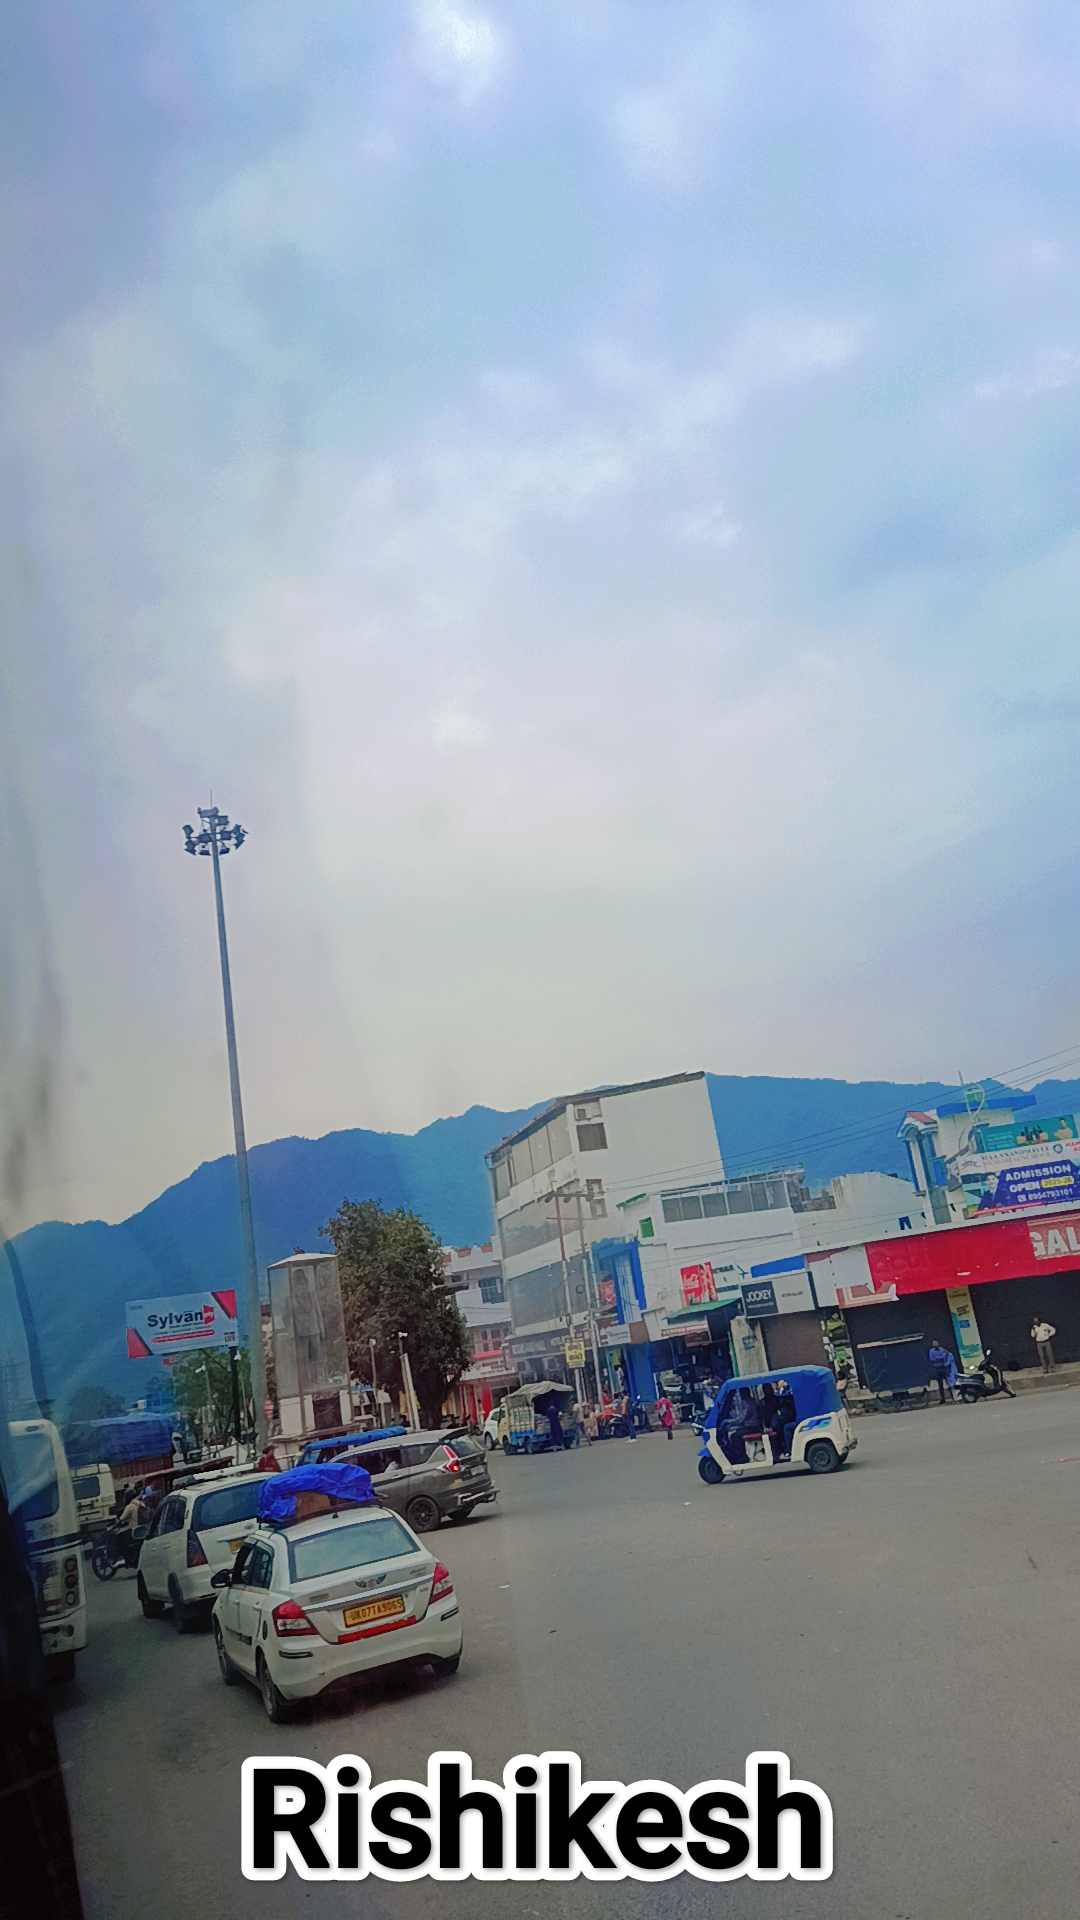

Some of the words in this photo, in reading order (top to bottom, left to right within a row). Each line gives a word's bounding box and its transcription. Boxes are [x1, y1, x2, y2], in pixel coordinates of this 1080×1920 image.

[1005, 1164, 1071, 1181] ADMISSION
[1009, 1181, 1040, 1193] OPEN
[1043, 1176, 1072, 1187] 2025-26
[746, 1289, 772, 1302] JOCKEY
